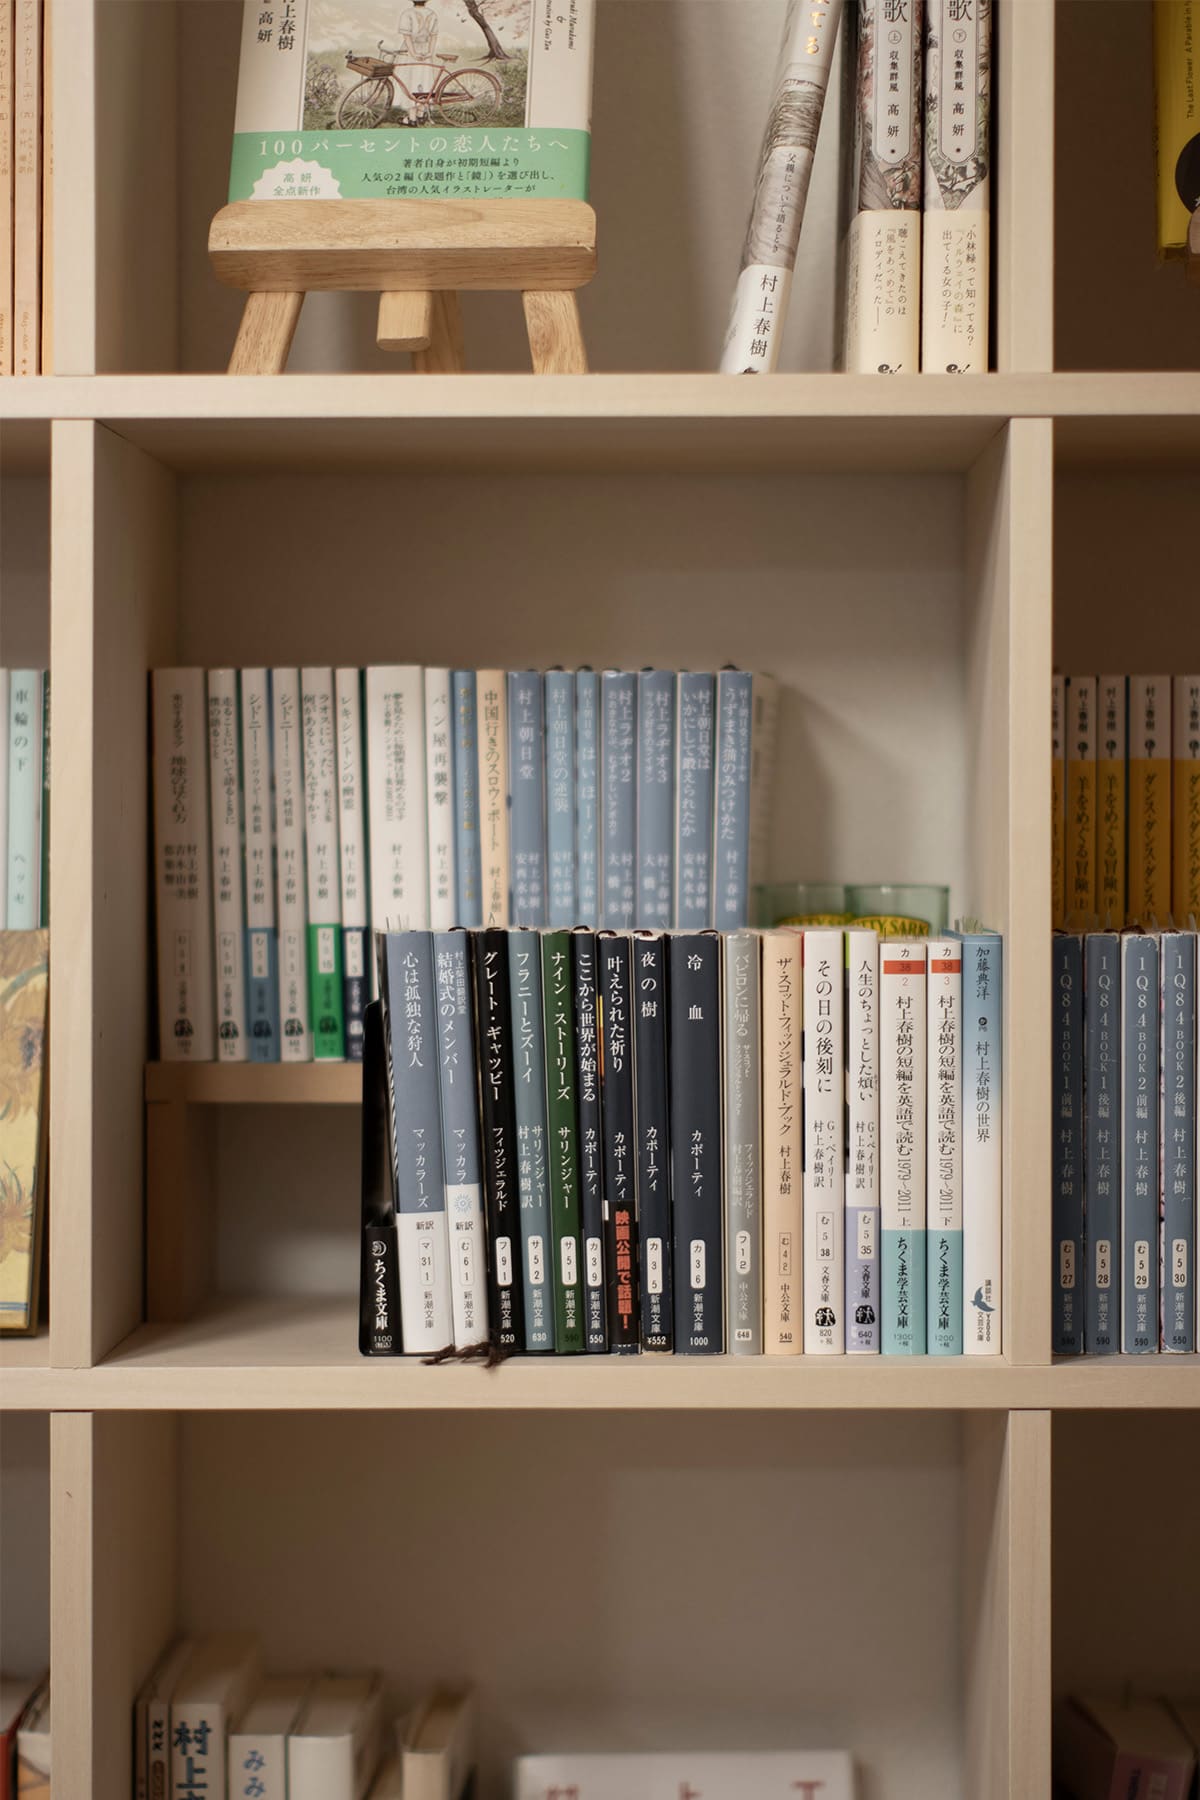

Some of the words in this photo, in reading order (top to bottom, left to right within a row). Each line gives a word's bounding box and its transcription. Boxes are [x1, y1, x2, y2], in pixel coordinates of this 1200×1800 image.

[278, 0, 297, 51] 上春樹
[882, 0, 908, 22] 歌
[947, 0, 972, 21] 歌
[259, 134, 569, 156] 100パーセントの恋人たちへ
[403, 157, 520, 168] 著者自身が初期短編より
[772, 152, 797, 253] 父親について語るとき
[750, 273, 778, 358] 村上春樹
[433, 693, 448, 807] パン屋再襲撃
[519, 688, 535, 780] 村上朝日堂
[681, 692, 697, 838] いかにして鍛えられたか
[720, 687, 738, 841] うずまき猫のみつけかた
[484, 689, 501, 851] 中国行きのスロウ・ボート
[640, 951, 658, 1018] 夜の樹
[687, 953, 704, 1021] 冷血
[733, 954, 750, 1038] バビロンに帰る
[975, 946, 990, 1001] 加藤典洋
[402, 951, 424, 1068] 心は孤独な狩人
[437, 952, 459, 1084] 結婚式のメンバー
[483, 951, 503, 1101] グレート・ギャツビー
[551, 952, 571, 1101] ナイン・ストーリーズ
[579, 953, 597, 1102] ここから世界が始まる
[607, 956, 626, 1073] 叶えられた祈り
[815, 960, 834, 1094] その日の後刻に
[857, 959, 874, 1102] 人生のちょっとした煩い
[516, 952, 534, 1083] フラニーとズーイ
[531, 1125, 545, 1208] サリンジャー
[776, 957, 794, 1136] ザ・スコット・フィッツジェラルド・ブック
[896, 996, 914, 1156] 村上春樹の短編を英語で読む
[937, 995, 955, 1156] 村上春樹の短編を英語で読む
[975, 1041, 991, 1143] 村上春樹の世界
[412, 1128, 429, 1209] マッカラーズ
[518, 1125, 533, 1209] 村上春樹訳
[558, 1127, 573, 1209] サリンジャー
[585, 1127, 598, 1195] カポーティ
[614, 1131, 627, 1199] カポーティ
[646, 1126, 660, 1192] カポーティ
[691, 1130, 704, 1198] カポーティ
[779, 1145, 792, 1195] 村上春樹
[813, 1120, 825, 1188] 村上春樹訳
[855, 1121, 866, 1190] 村上春樹訳
[1060, 1129, 1075, 1196] 村上春樹
[1096, 1129, 1110, 1196] 村上春樹
[1135, 1129, 1149, 1197] 村上春樹
[1173, 1128, 1187, 1195] 村上春樹
[415, 1220, 434, 1231] 新訳
[455, 1220, 474, 1231] 新訳
[374, 1259, 390, 1331] ちくま文庫
[423, 1290, 434, 1329] 新潮文庫
[463, 1290, 475, 1330] 新潮文庫
[501, 1290, 512, 1330] 新潮文庫
[532, 1289, 544, 1328] 新潮文庫
[565, 1290, 576, 1329] 新潮文庫
[590, 1290, 601, 1330] 新潮文庫
[650, 1294, 661, 1334] 新潮文庫
[693, 1293, 704, 1332] 新潮文庫
[780, 1283, 791, 1322] 中公文庫
[821, 1266, 830, 1303] 文春文庫
[862, 1264, 871, 1299] 文春文庫
[897, 1236, 909, 1330] ちくま学芸文庫
[938, 1237, 950, 1331] ちくま学芸文庫
[1063, 1293, 1073, 1332] 新潮文庫
[1099, 1293, 1108, 1332] 新潮文庫
[1136, 1294, 1147, 1332] 新潮文庫
[1174, 1292, 1185, 1331] 新潮文庫
[500, 1334, 515, 1343] 520
[532, 1333, 547, 1342] 630
[589, 1334, 604, 1344] 550
[689, 1337, 709, 1346] 1000
[737, 1331, 750, 1339] 648
[779, 1332, 793, 1340] 540
[819, 1329, 832, 1337] 820
[858, 1331, 873, 1339] 640
[1134, 1337, 1149, 1347] 590
[1172, 1335, 1187, 1345] 550
